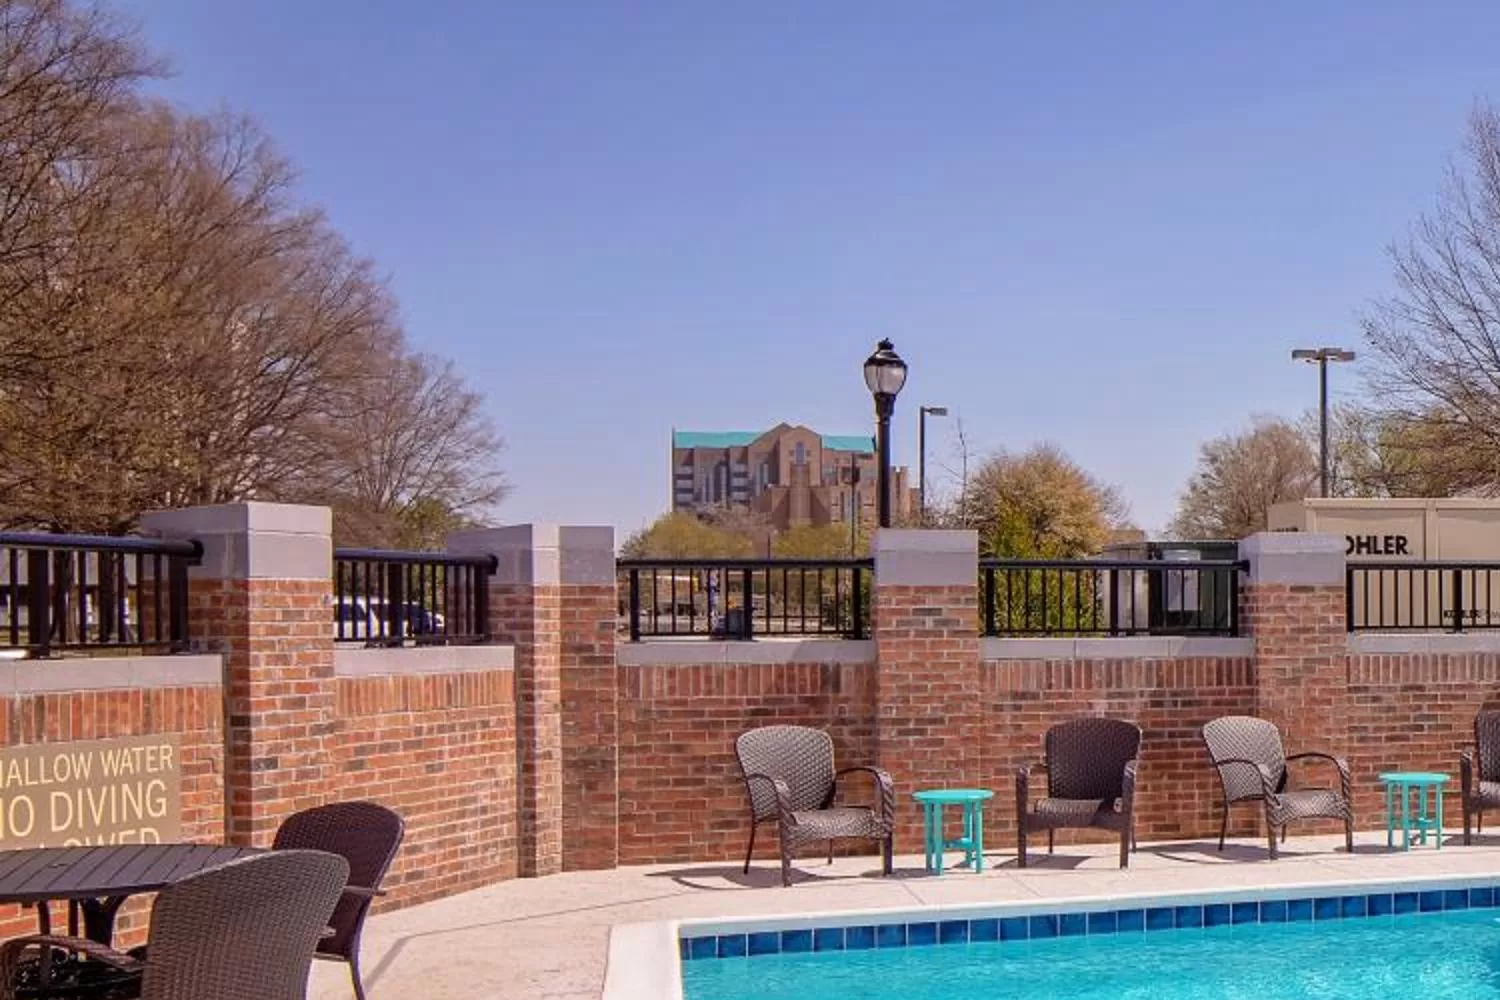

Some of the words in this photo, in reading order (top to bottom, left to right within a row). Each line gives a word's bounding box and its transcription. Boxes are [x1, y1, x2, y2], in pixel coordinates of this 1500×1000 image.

[0, 751, 93, 789] ALLOW
[100, 744, 174, 777] WATER
[51, 779, 168, 833] DIVING
